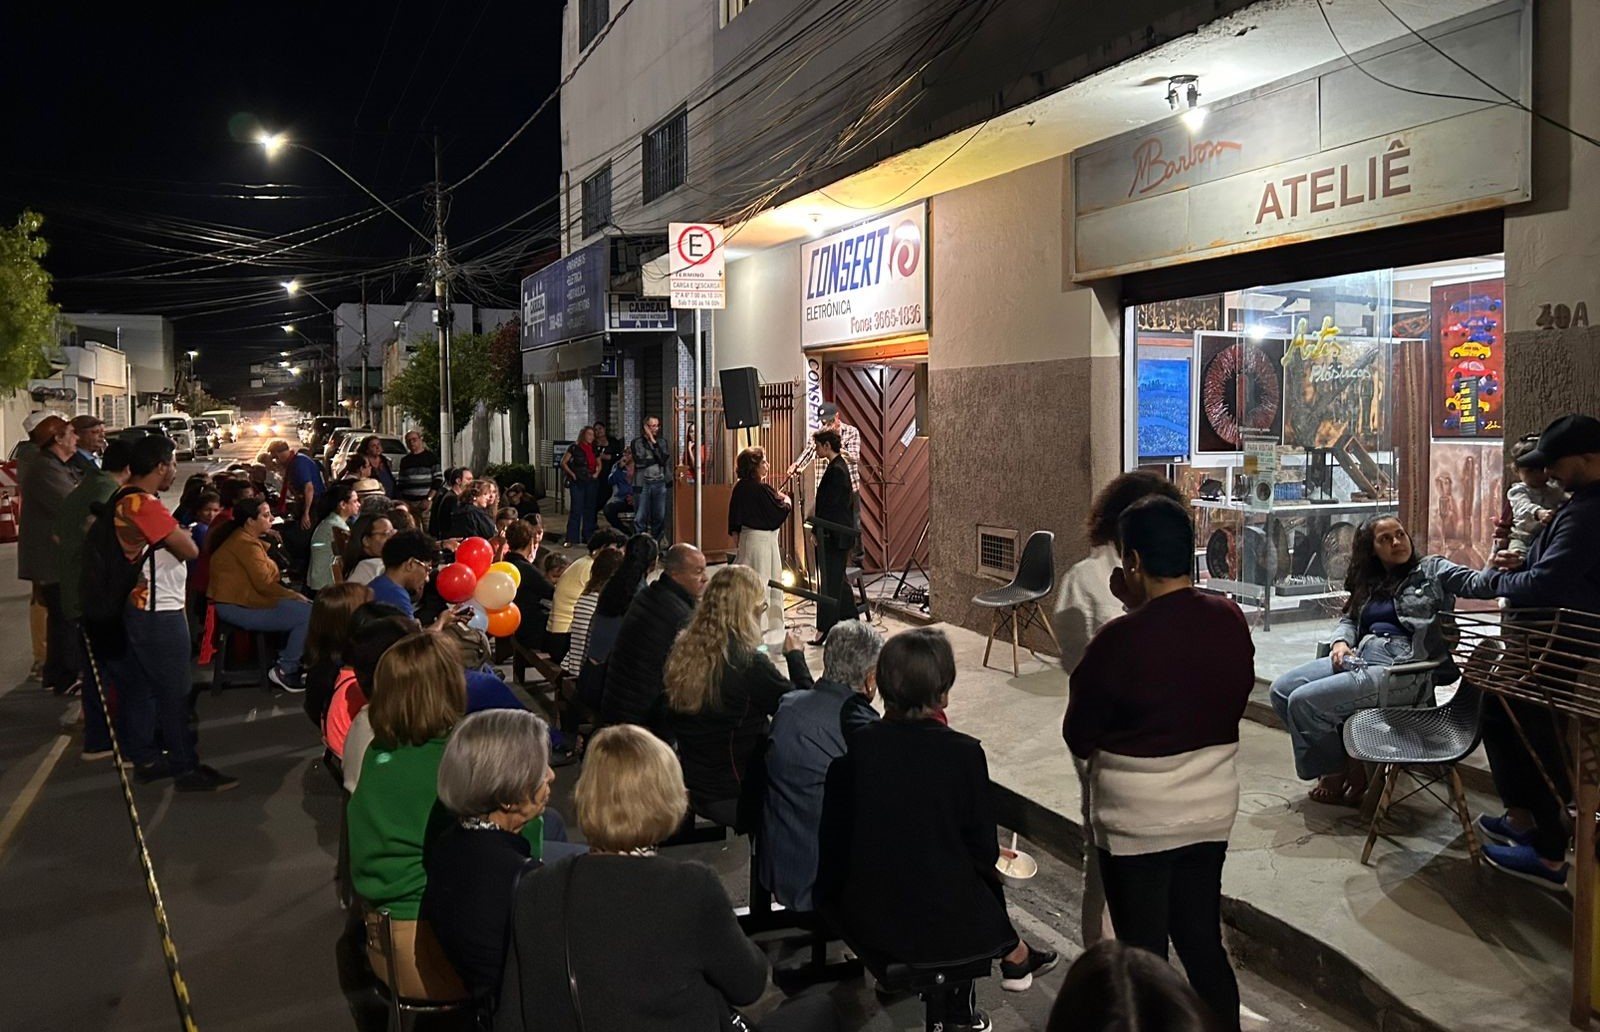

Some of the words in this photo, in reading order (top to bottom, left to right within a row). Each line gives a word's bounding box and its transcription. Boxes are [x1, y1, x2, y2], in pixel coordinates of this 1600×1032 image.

[1255, 139, 1412, 225] ATELIÊ
[689, 233, 703, 257] E
[806, 225, 890, 300] CONSERT
[629, 302, 666, 312] CARDEAL
[806, 299, 852, 322] ELETRÔNICA
